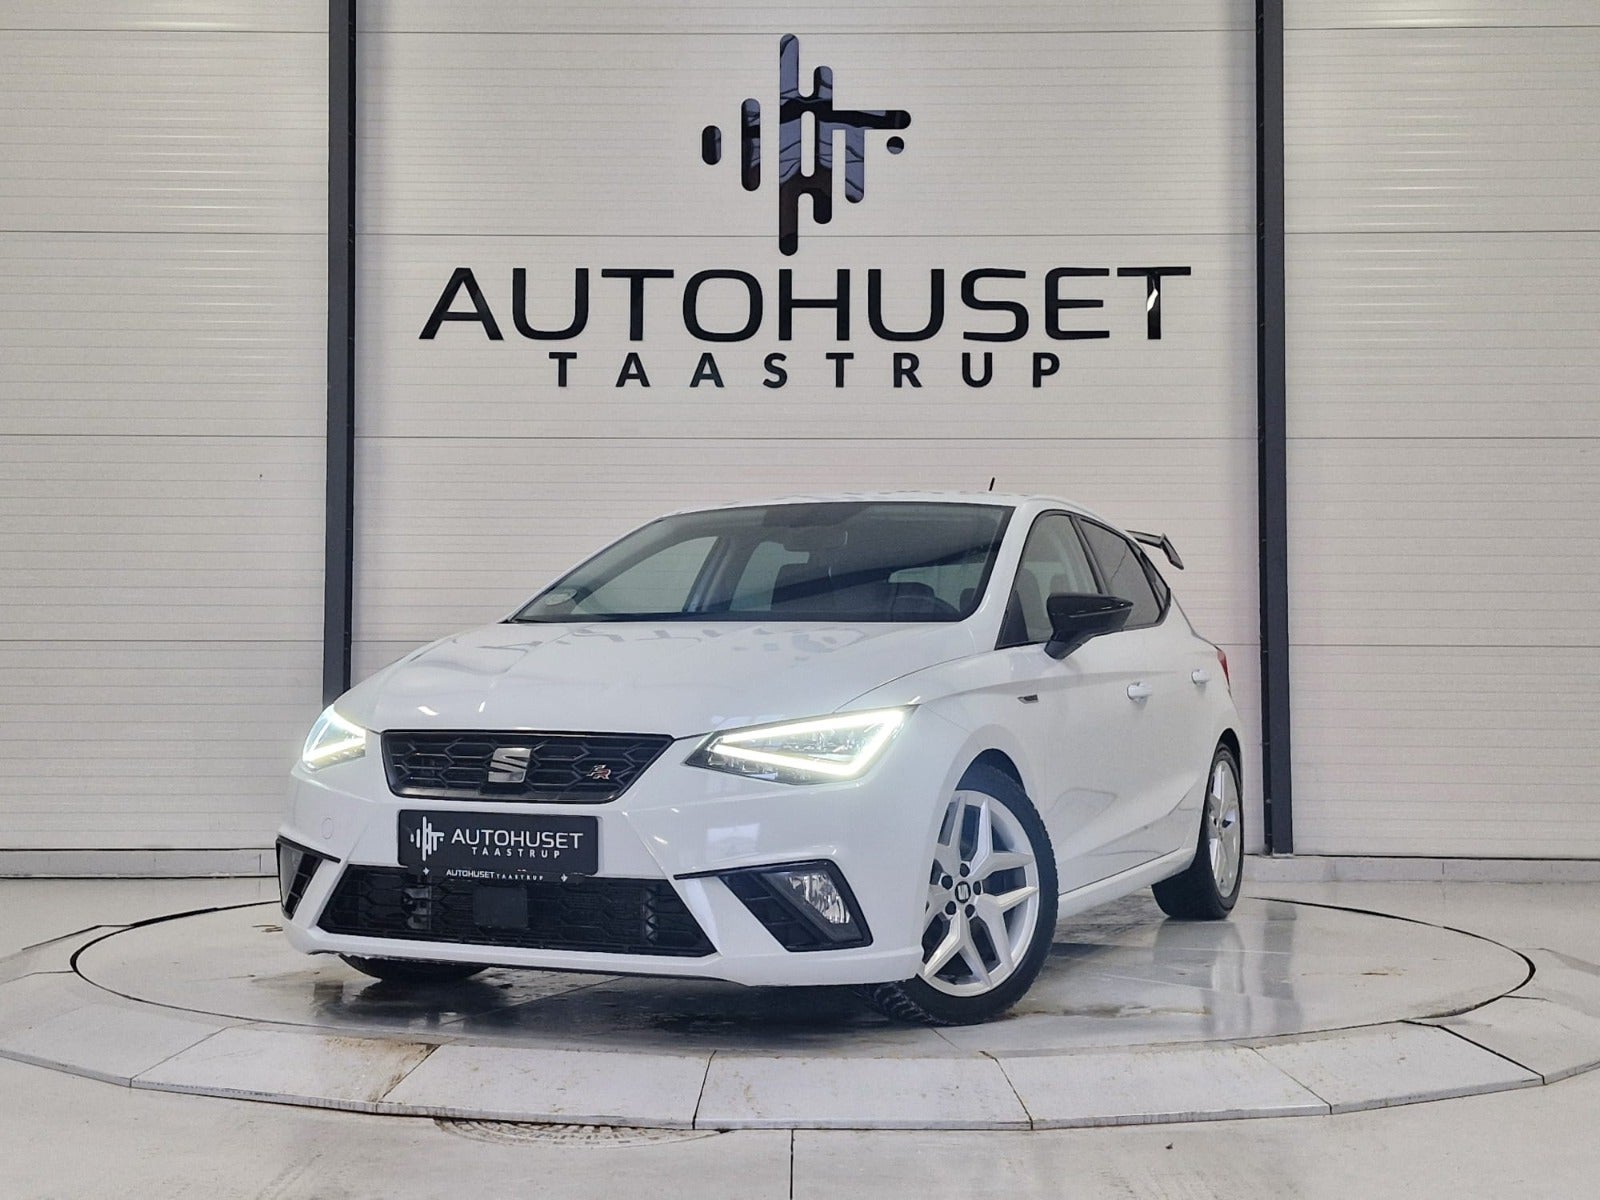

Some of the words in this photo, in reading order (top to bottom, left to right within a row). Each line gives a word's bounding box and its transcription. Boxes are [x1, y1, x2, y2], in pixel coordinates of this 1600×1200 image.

[419, 266, 1191, 342] AUTOHUSET
[548, 352, 1060, 388] TAASTRUP
[451, 828, 584, 849] AUTOHUSET
[472, 846, 561, 859] TAASTRUP
[446, 869, 495, 879] AUTOHUSET
